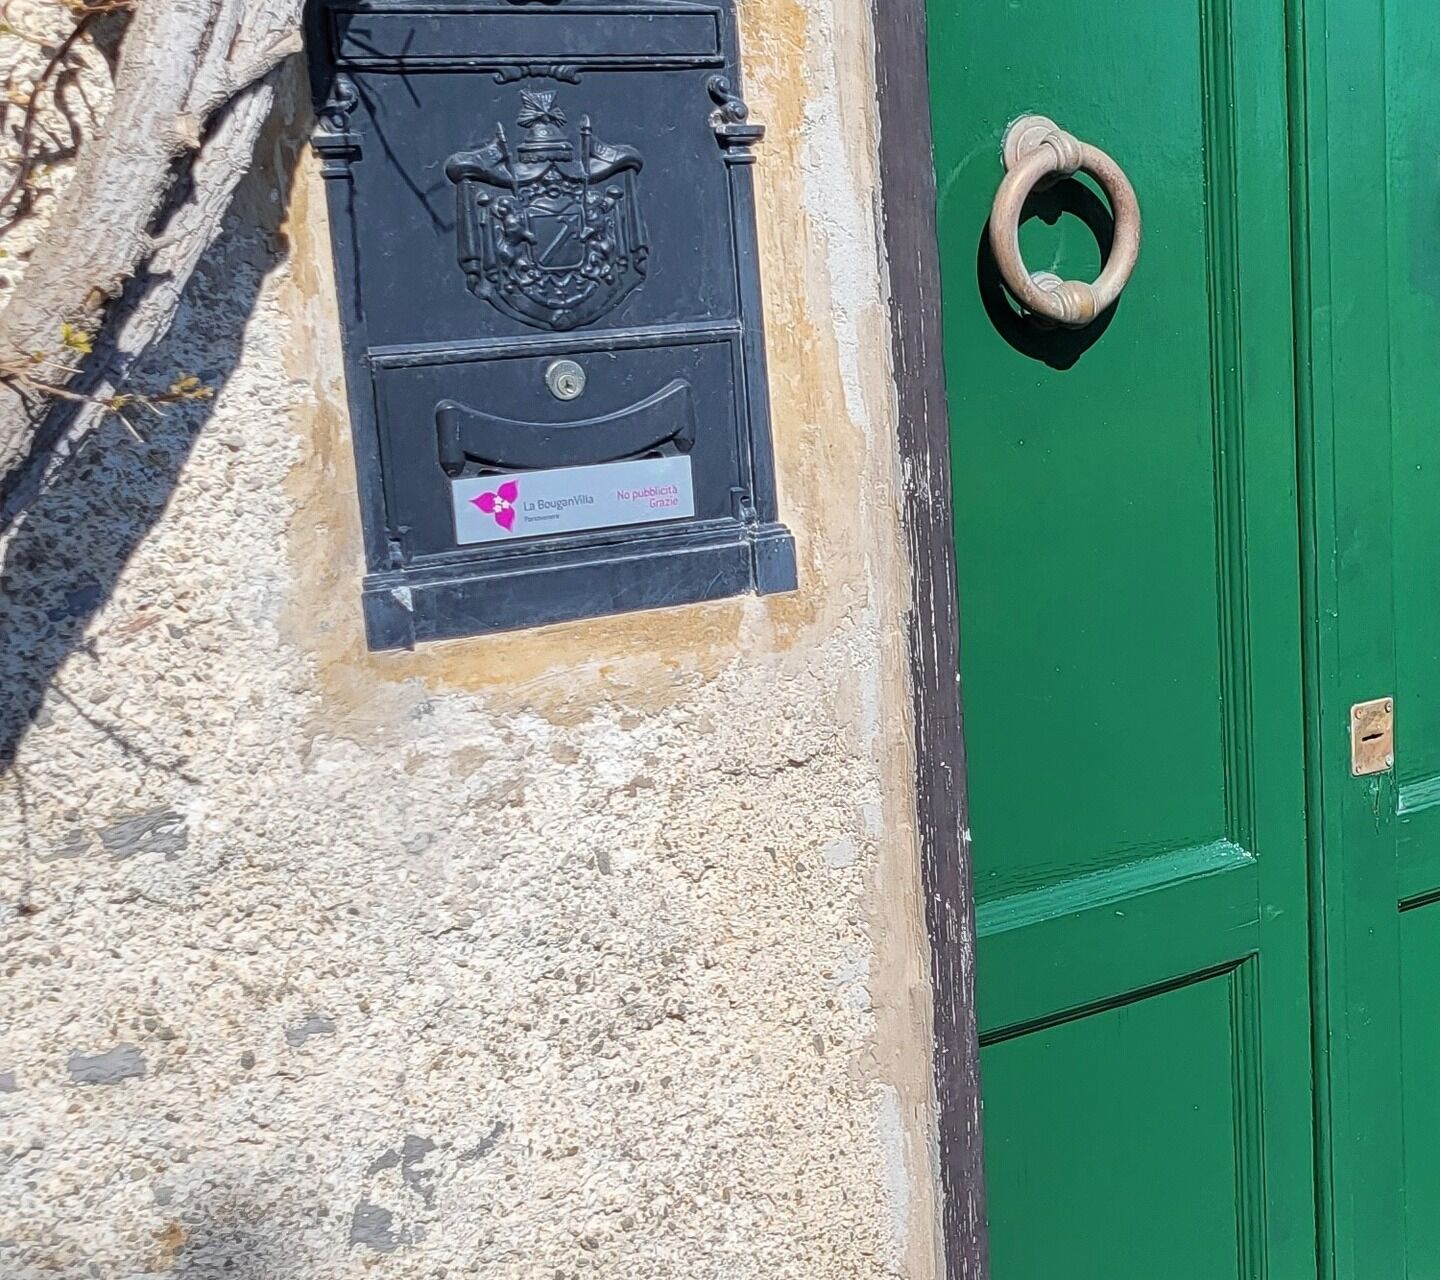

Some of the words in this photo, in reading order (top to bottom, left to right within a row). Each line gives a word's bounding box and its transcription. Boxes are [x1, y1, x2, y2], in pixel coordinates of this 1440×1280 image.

[617, 489, 630, 500] No
[632, 485, 678, 501] pubblicità
[523, 501, 535, 511] La
[537, 495, 594, 510] BouganVilla
[650, 497, 678, 508] Grazie
